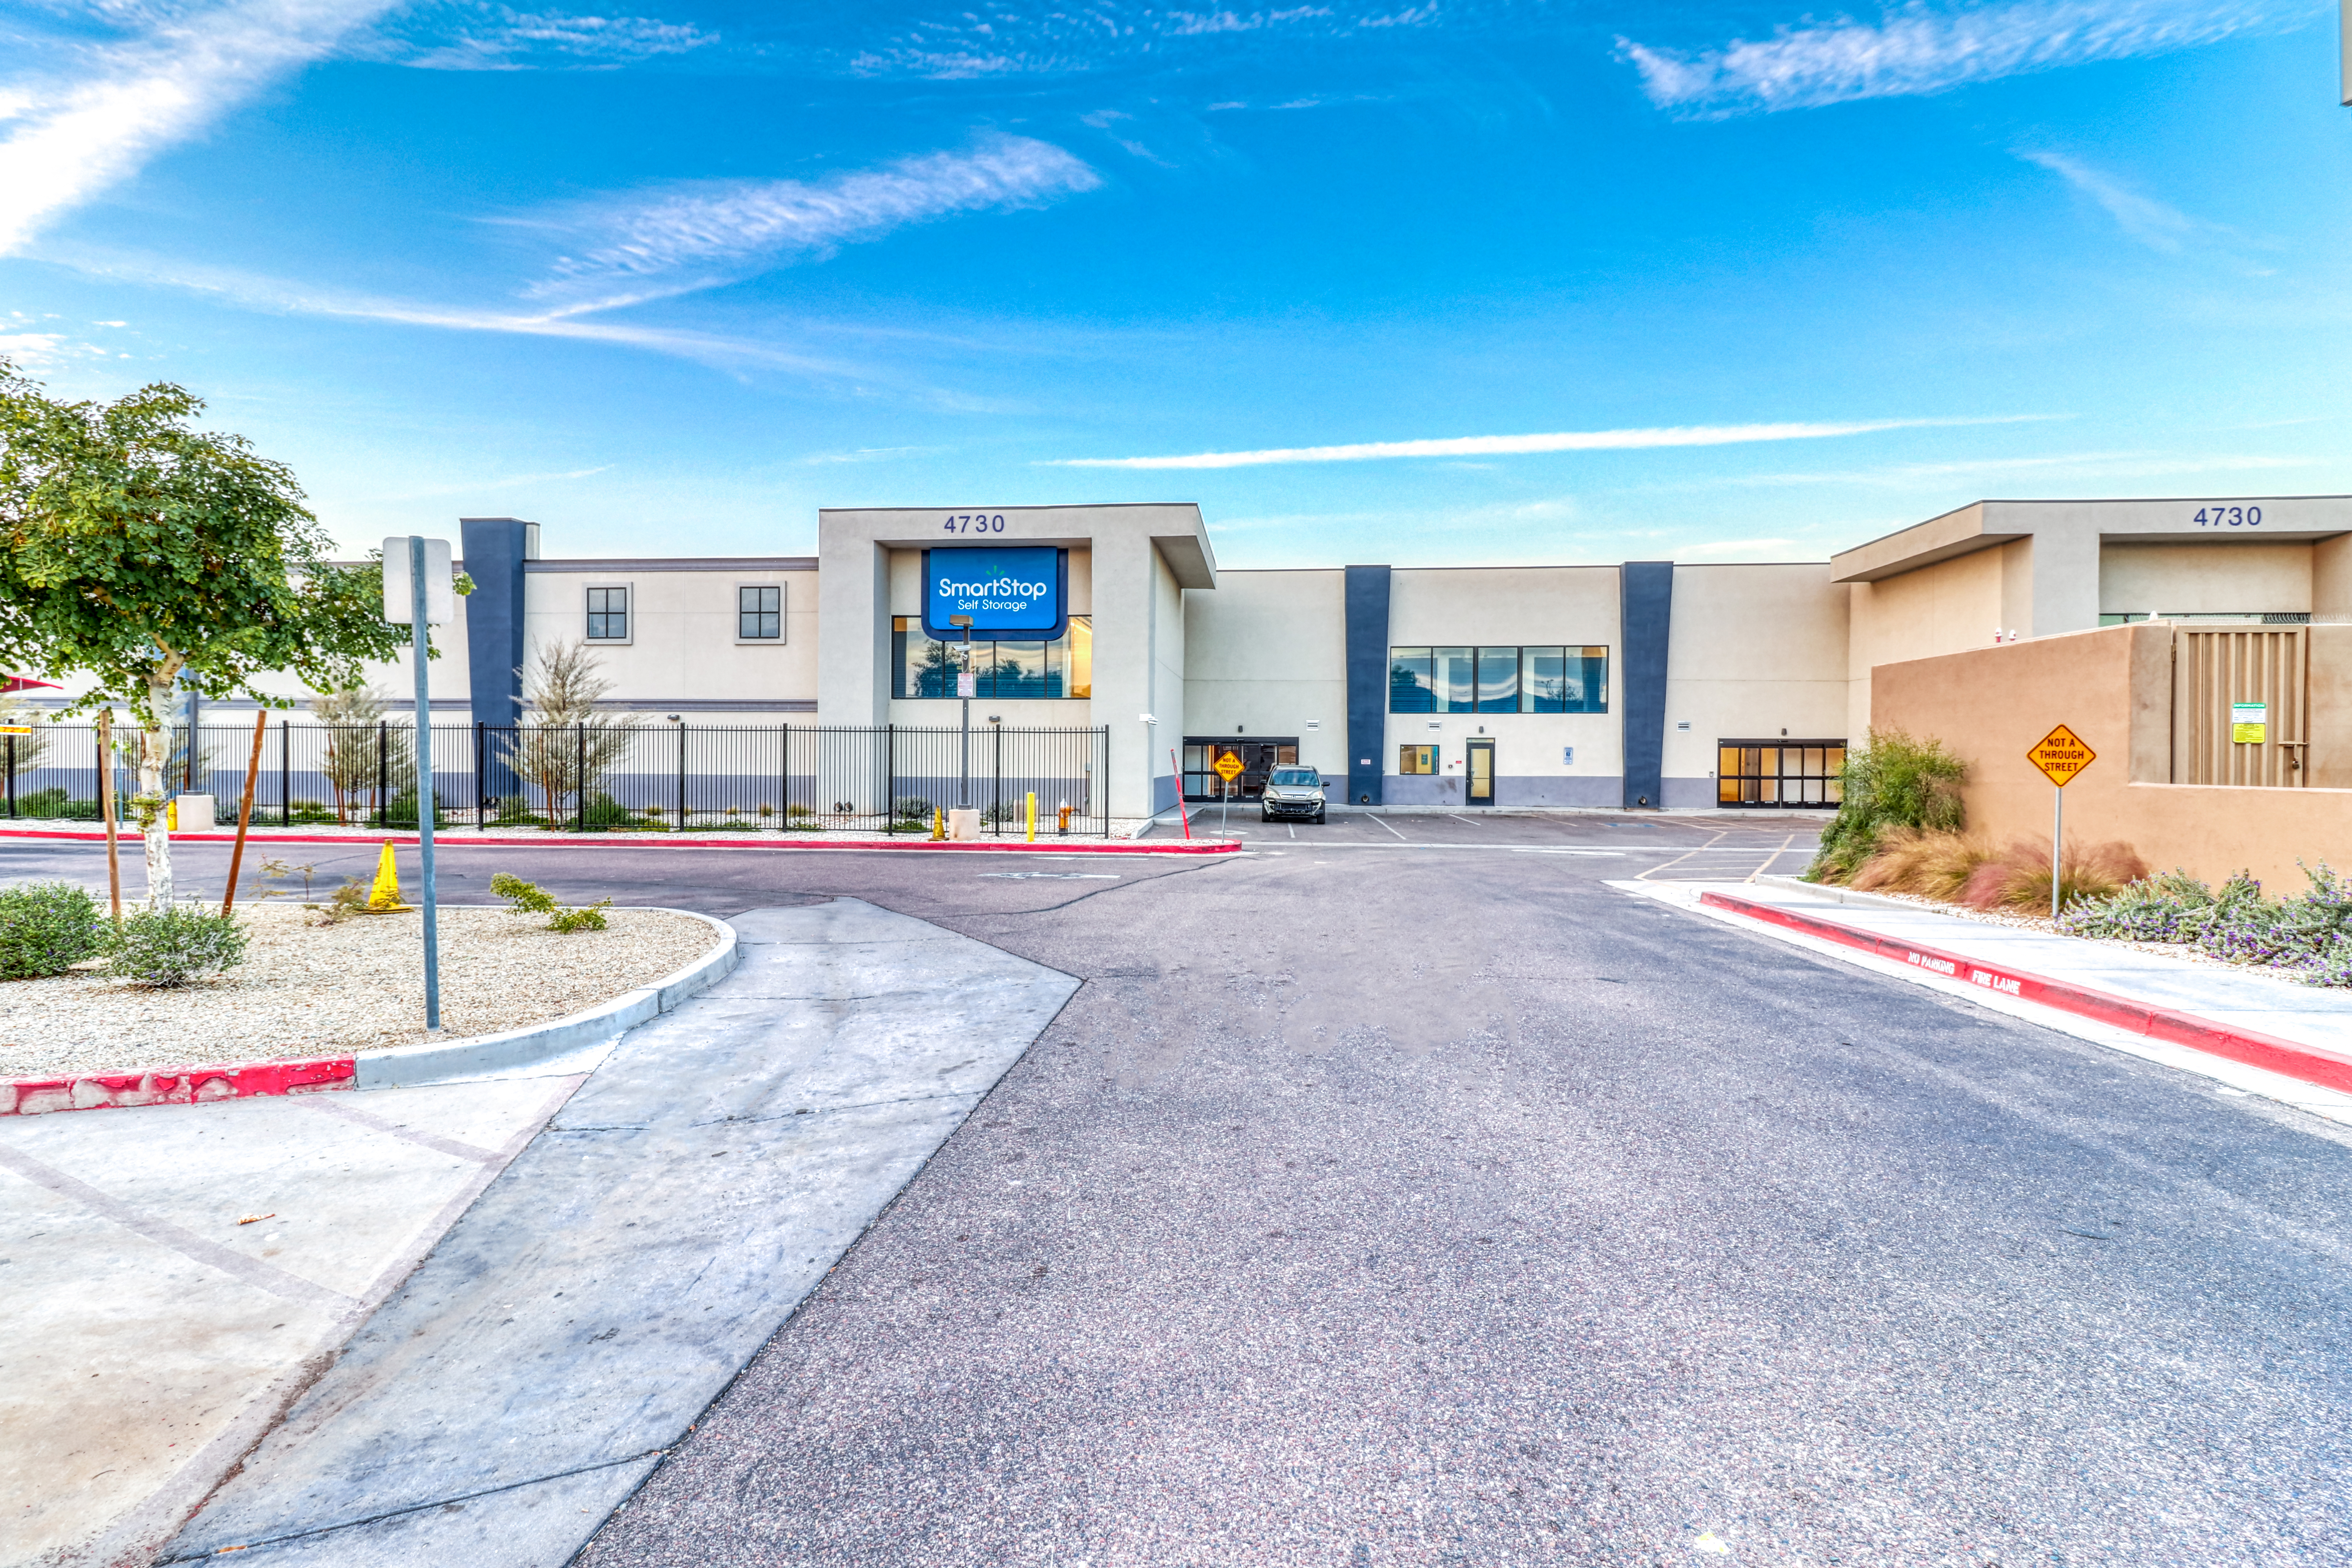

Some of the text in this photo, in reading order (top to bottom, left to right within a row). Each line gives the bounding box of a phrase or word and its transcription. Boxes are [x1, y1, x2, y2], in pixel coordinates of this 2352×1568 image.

[2193, 506, 2261, 526] 4730
[944, 515, 1004, 533] 4730
[939, 577, 1047, 601] SmartStop
[958, 599, 1027, 612] Self Storage
[2047, 738, 2075, 747] NOT A
[2039, 750, 2084, 759] THROUGH
[2044, 762, 2078, 771] STREET
[1908, 951, 2020, 995] NO PARKING FIRE LANE
